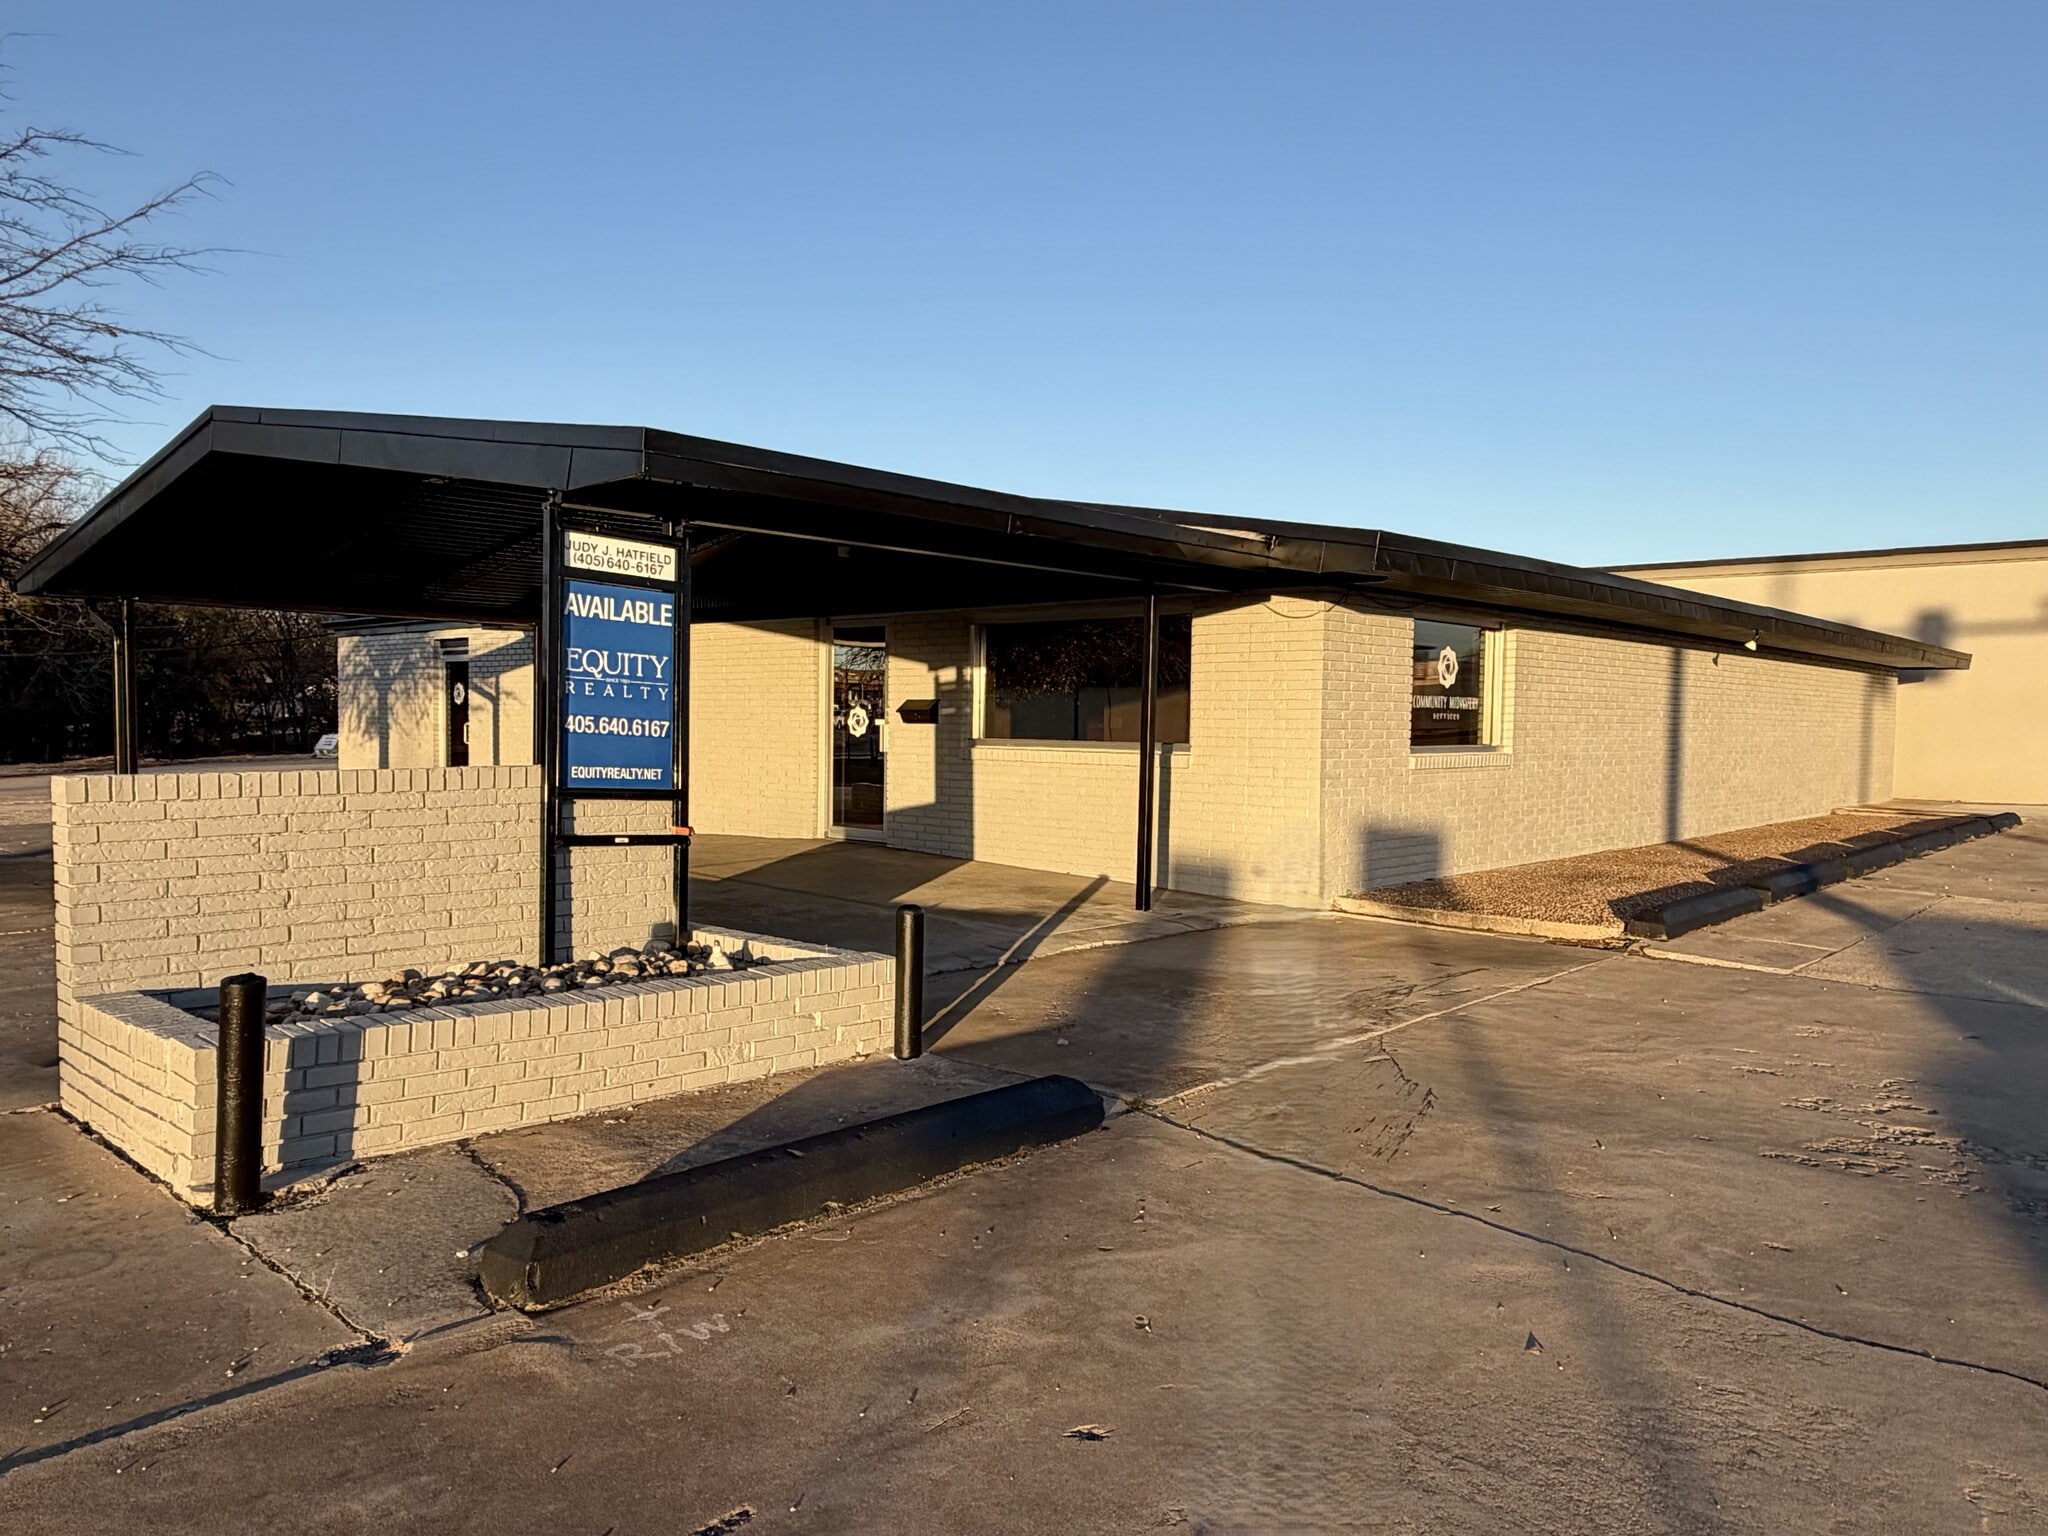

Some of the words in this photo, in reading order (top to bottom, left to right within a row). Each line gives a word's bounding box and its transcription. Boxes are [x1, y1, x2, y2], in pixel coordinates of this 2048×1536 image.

[565, 539, 598, 554] JUDY
[601, 546, 613, 556] J.
[616, 547, 672, 565] HATFIELD
[573, 553, 605, 568] (405)
[606, 557, 665, 576] 640-6167
[564, 592, 672, 627] AVAILABLE
[567, 647, 669, 679] EQUITY
[565, 681, 669, 701] REALTY
[1412, 695, 1448, 709] COMMUNITY
[565, 715, 670, 738] 405.640.6167
[1432, 711, 1460, 720] services
[571, 766, 663, 780] EQUITYREALTY.NET
